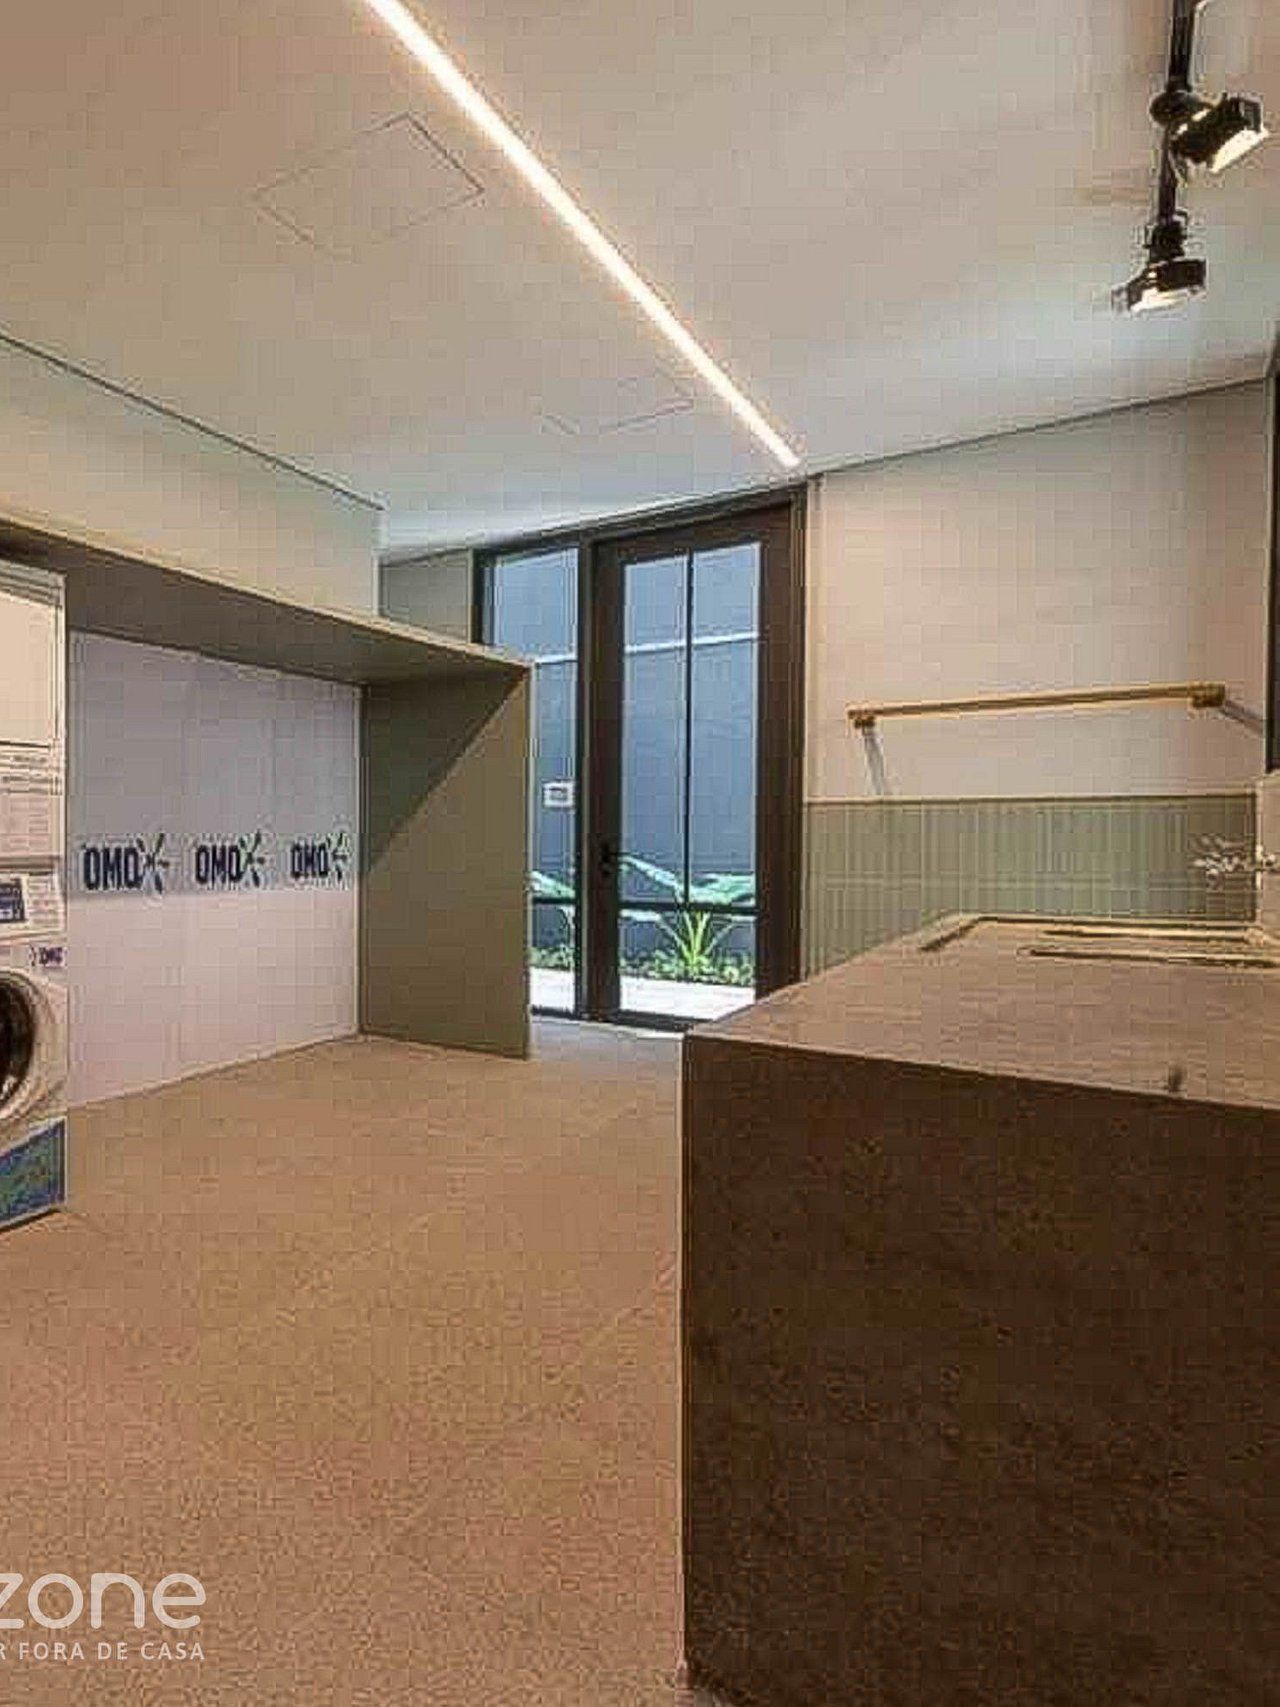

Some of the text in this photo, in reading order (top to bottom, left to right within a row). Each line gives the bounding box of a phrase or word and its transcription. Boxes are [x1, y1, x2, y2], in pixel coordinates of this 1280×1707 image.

[83, 846, 141, 890] OMO
[195, 844, 242, 884] OMO
[290, 843, 328, 878] OMO
